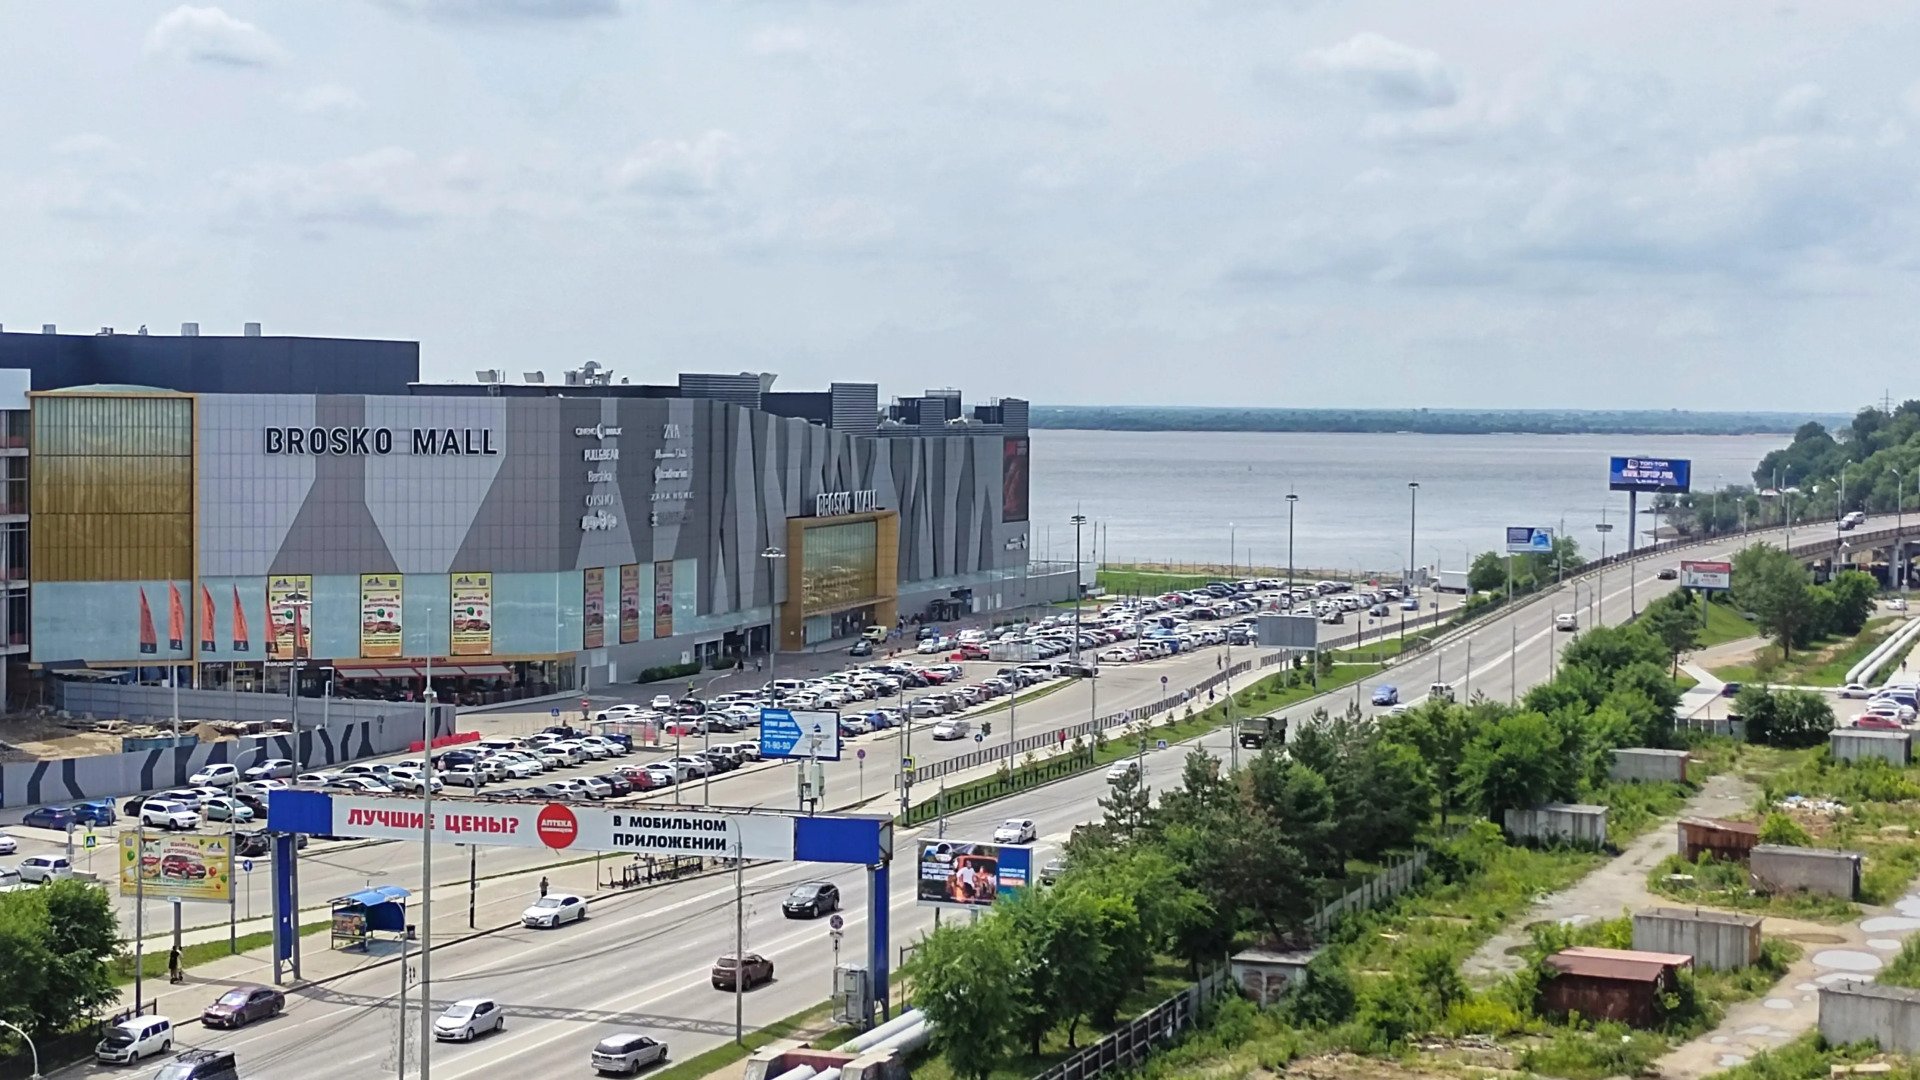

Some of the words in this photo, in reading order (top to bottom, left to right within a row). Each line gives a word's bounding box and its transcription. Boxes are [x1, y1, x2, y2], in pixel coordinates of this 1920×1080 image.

[265, 426, 393, 455] BROSKO
[411, 427, 498, 455] MALL
[815, 491, 851, 517] BROSKO
[854, 489, 878, 513] MALL
[445, 814, 519, 834] ЦЕНЫ?
[541, 819, 573, 827] АПТЕКА
[613, 815, 622, 827] В
[629, 816, 727, 832] МОБИЛЬНОМ
[613, 833, 727, 851] ПРИЛОЖЕНИИ
